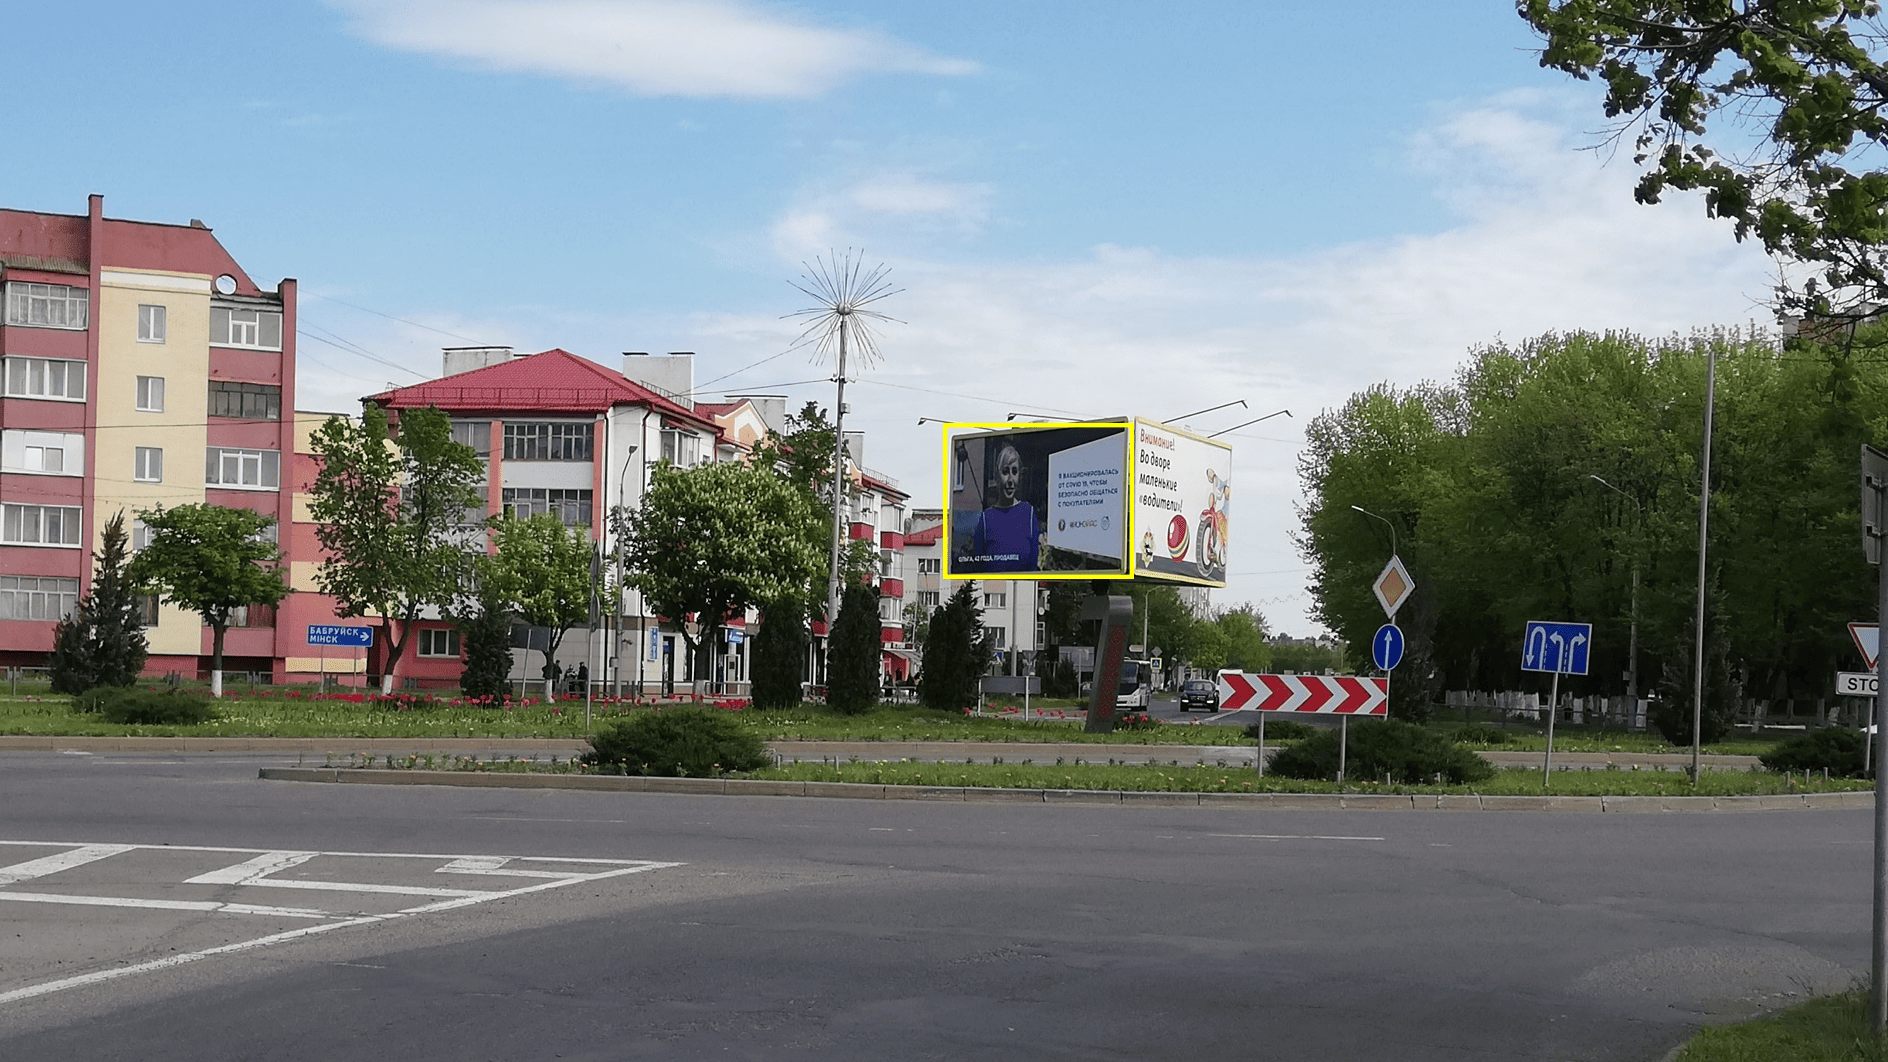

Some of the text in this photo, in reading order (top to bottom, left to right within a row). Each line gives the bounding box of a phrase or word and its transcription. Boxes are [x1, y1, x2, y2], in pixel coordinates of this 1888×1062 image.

[1141, 428, 1175, 451] Внимание!
[1140, 449, 1170, 472] Во дворе
[1139, 473, 1177, 492] маленькие
[1058, 488, 1118, 498] БЕЗОПАСНО ОБЩАТЬСЯ
[1062, 499, 1104, 507] ПОКУПАТЕЛЯМИ
[1139, 492, 1183, 513] «водители»!
[310, 626, 359, 636] БАБРУЙСК
[309, 635, 338, 643] МІНСК
[1847, 677, 1879, 692] STO
